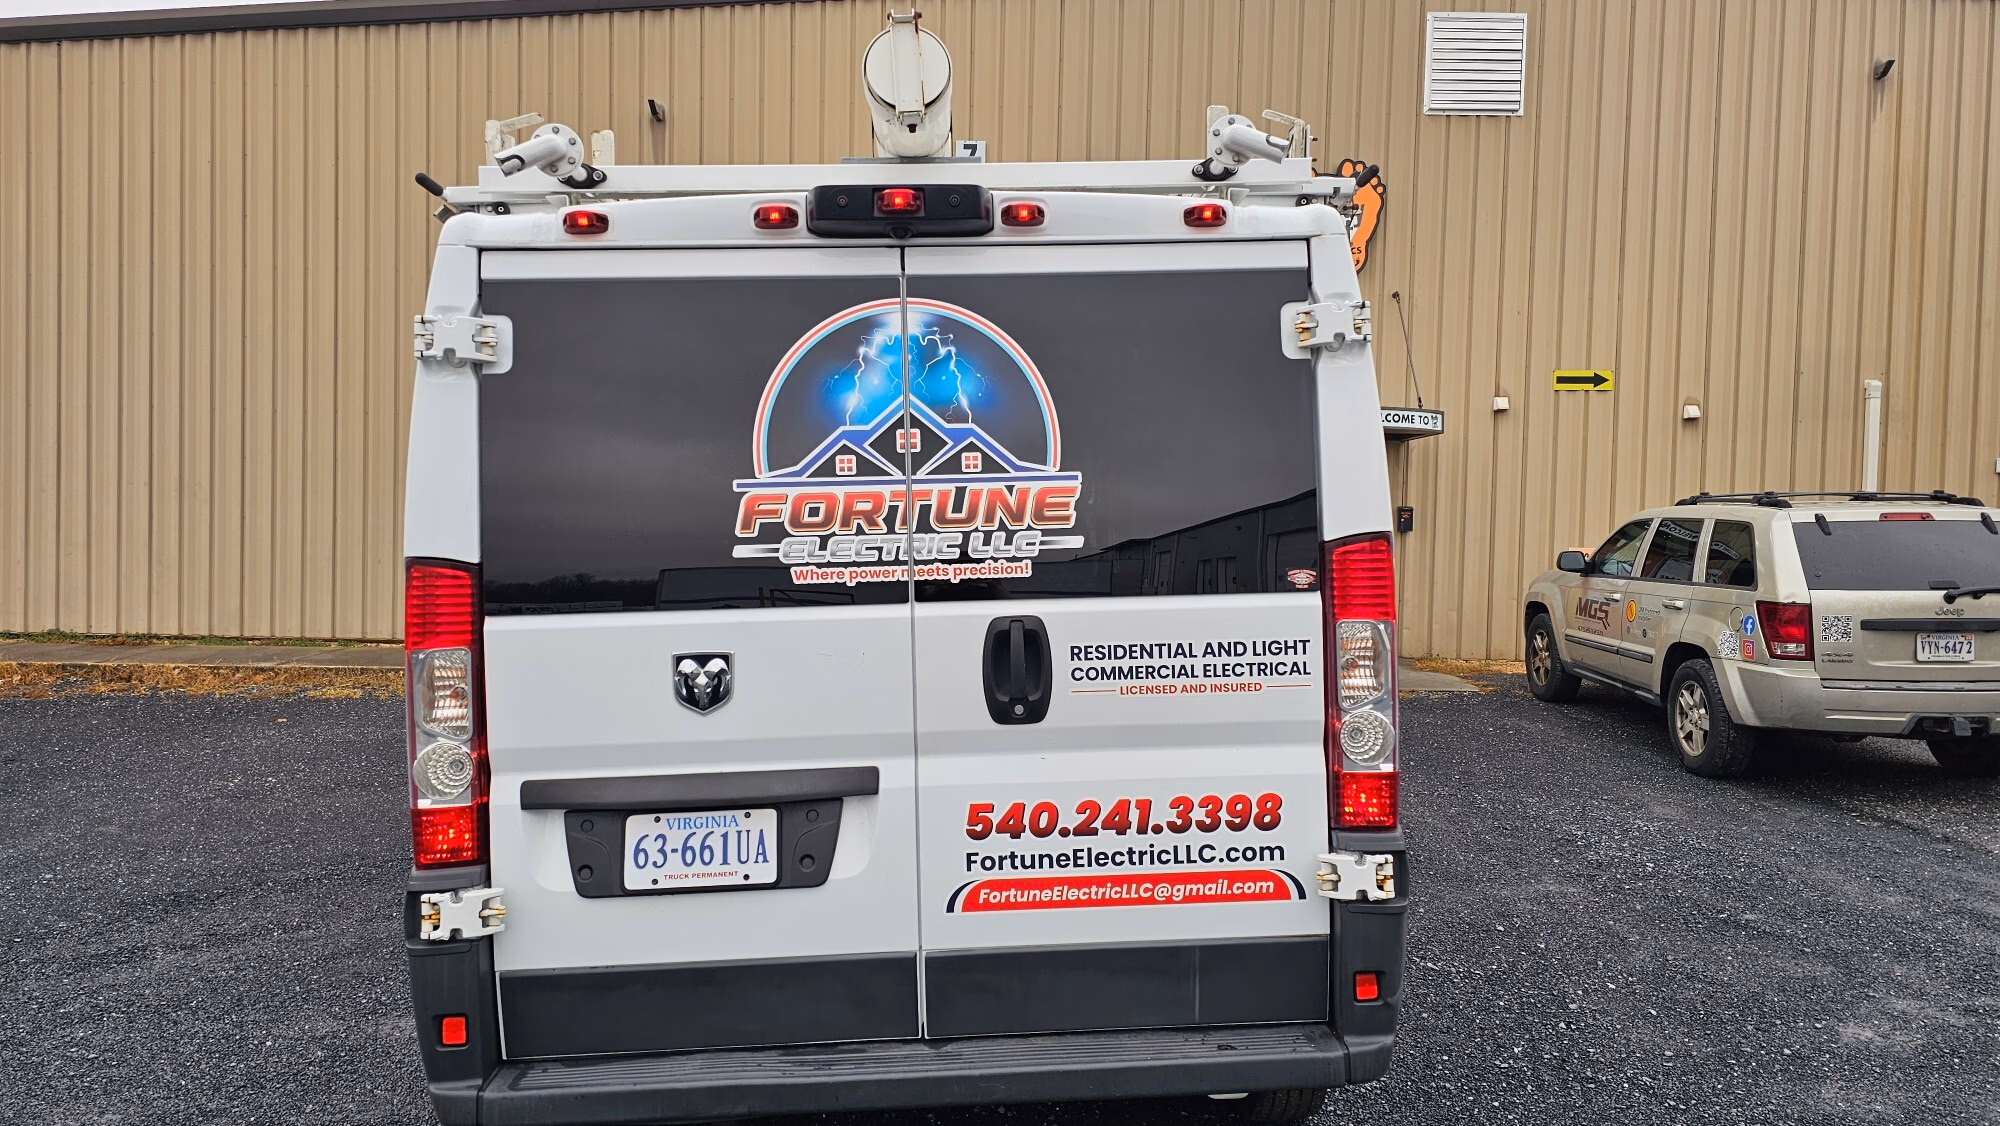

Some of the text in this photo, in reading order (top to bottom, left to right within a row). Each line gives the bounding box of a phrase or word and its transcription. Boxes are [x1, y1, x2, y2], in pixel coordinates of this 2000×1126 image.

[963, 143, 978, 157] 7
[1418, 415, 1430, 425] TO
[736, 485, 1079, 536] FORTUNE
[781, 531, 1040, 561] ELECTRIC LLC
[793, 562, 1030, 584] Where power meets precision!
[1575, 597, 1611, 620] MGS
[1935, 606, 1965, 618] Jeep
[1069, 639, 1311, 662] RESIDENTIAL AND LIGHT
[1920, 640, 1973, 654] VYN-6472
[1070, 661, 1312, 682] COMMERCIAL ELECTRICAL
[1119, 682, 1263, 696] LICENSED AND INSURED
[666, 815, 739, 831] VIRGINIA
[965, 793, 1283, 841] 540.241.3398
[633, 828, 770, 870] 63-661UA
[965, 843, 1286, 872] FortuneElectricLLC.com
[691, 870, 739, 879] PERMANENT
[978, 879, 1275, 905] FortuneElectricLLC@gmail.com
